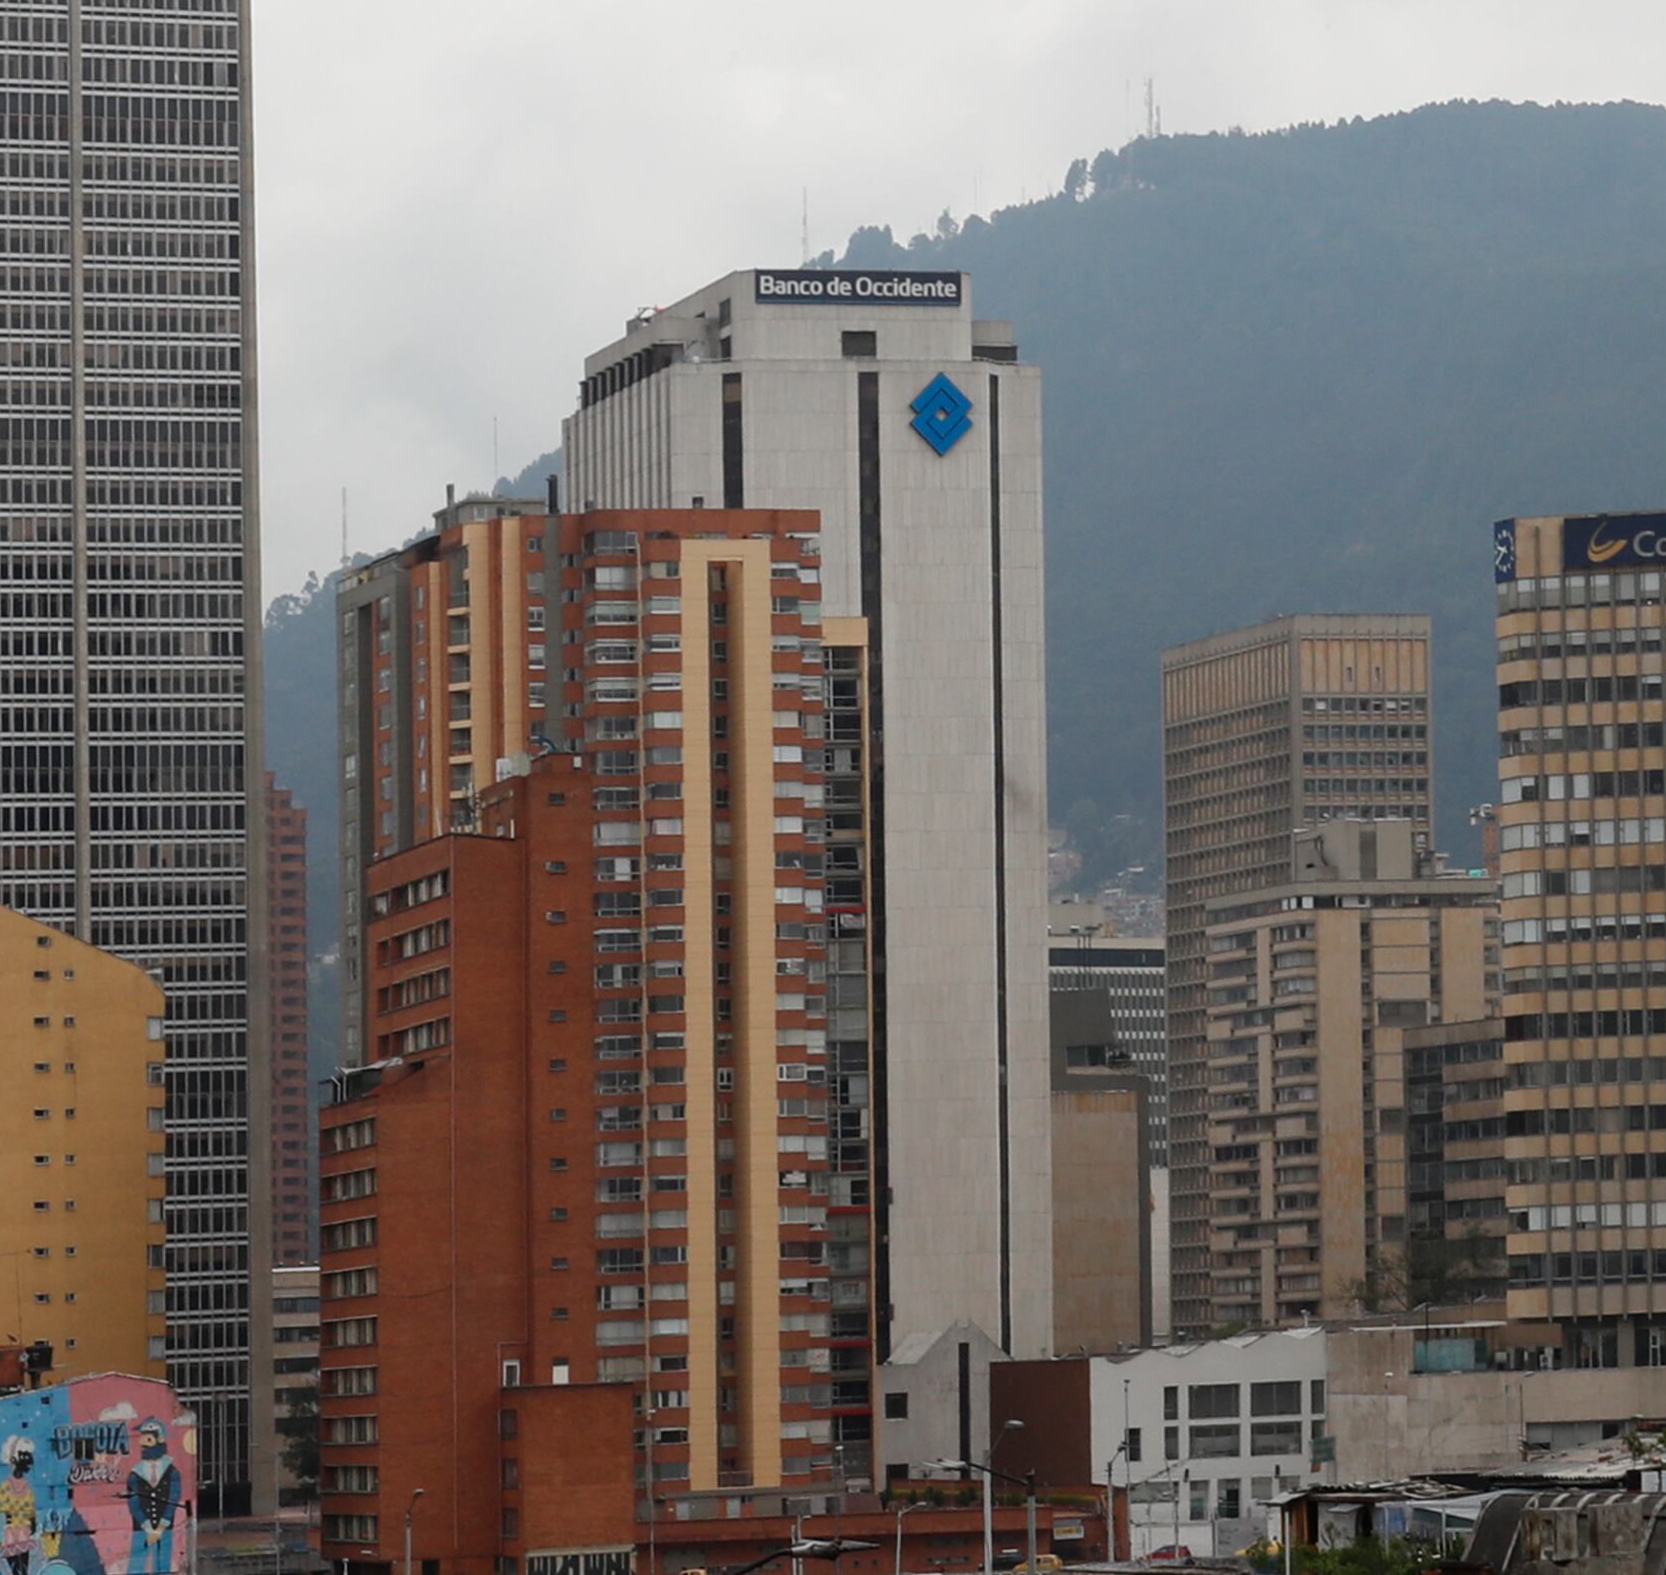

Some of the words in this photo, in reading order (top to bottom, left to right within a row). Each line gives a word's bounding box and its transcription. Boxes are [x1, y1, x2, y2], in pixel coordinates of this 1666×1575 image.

[759, 275, 823, 296] Banco
[827, 277, 852, 296] de
[855, 277, 958, 298] Occidente
